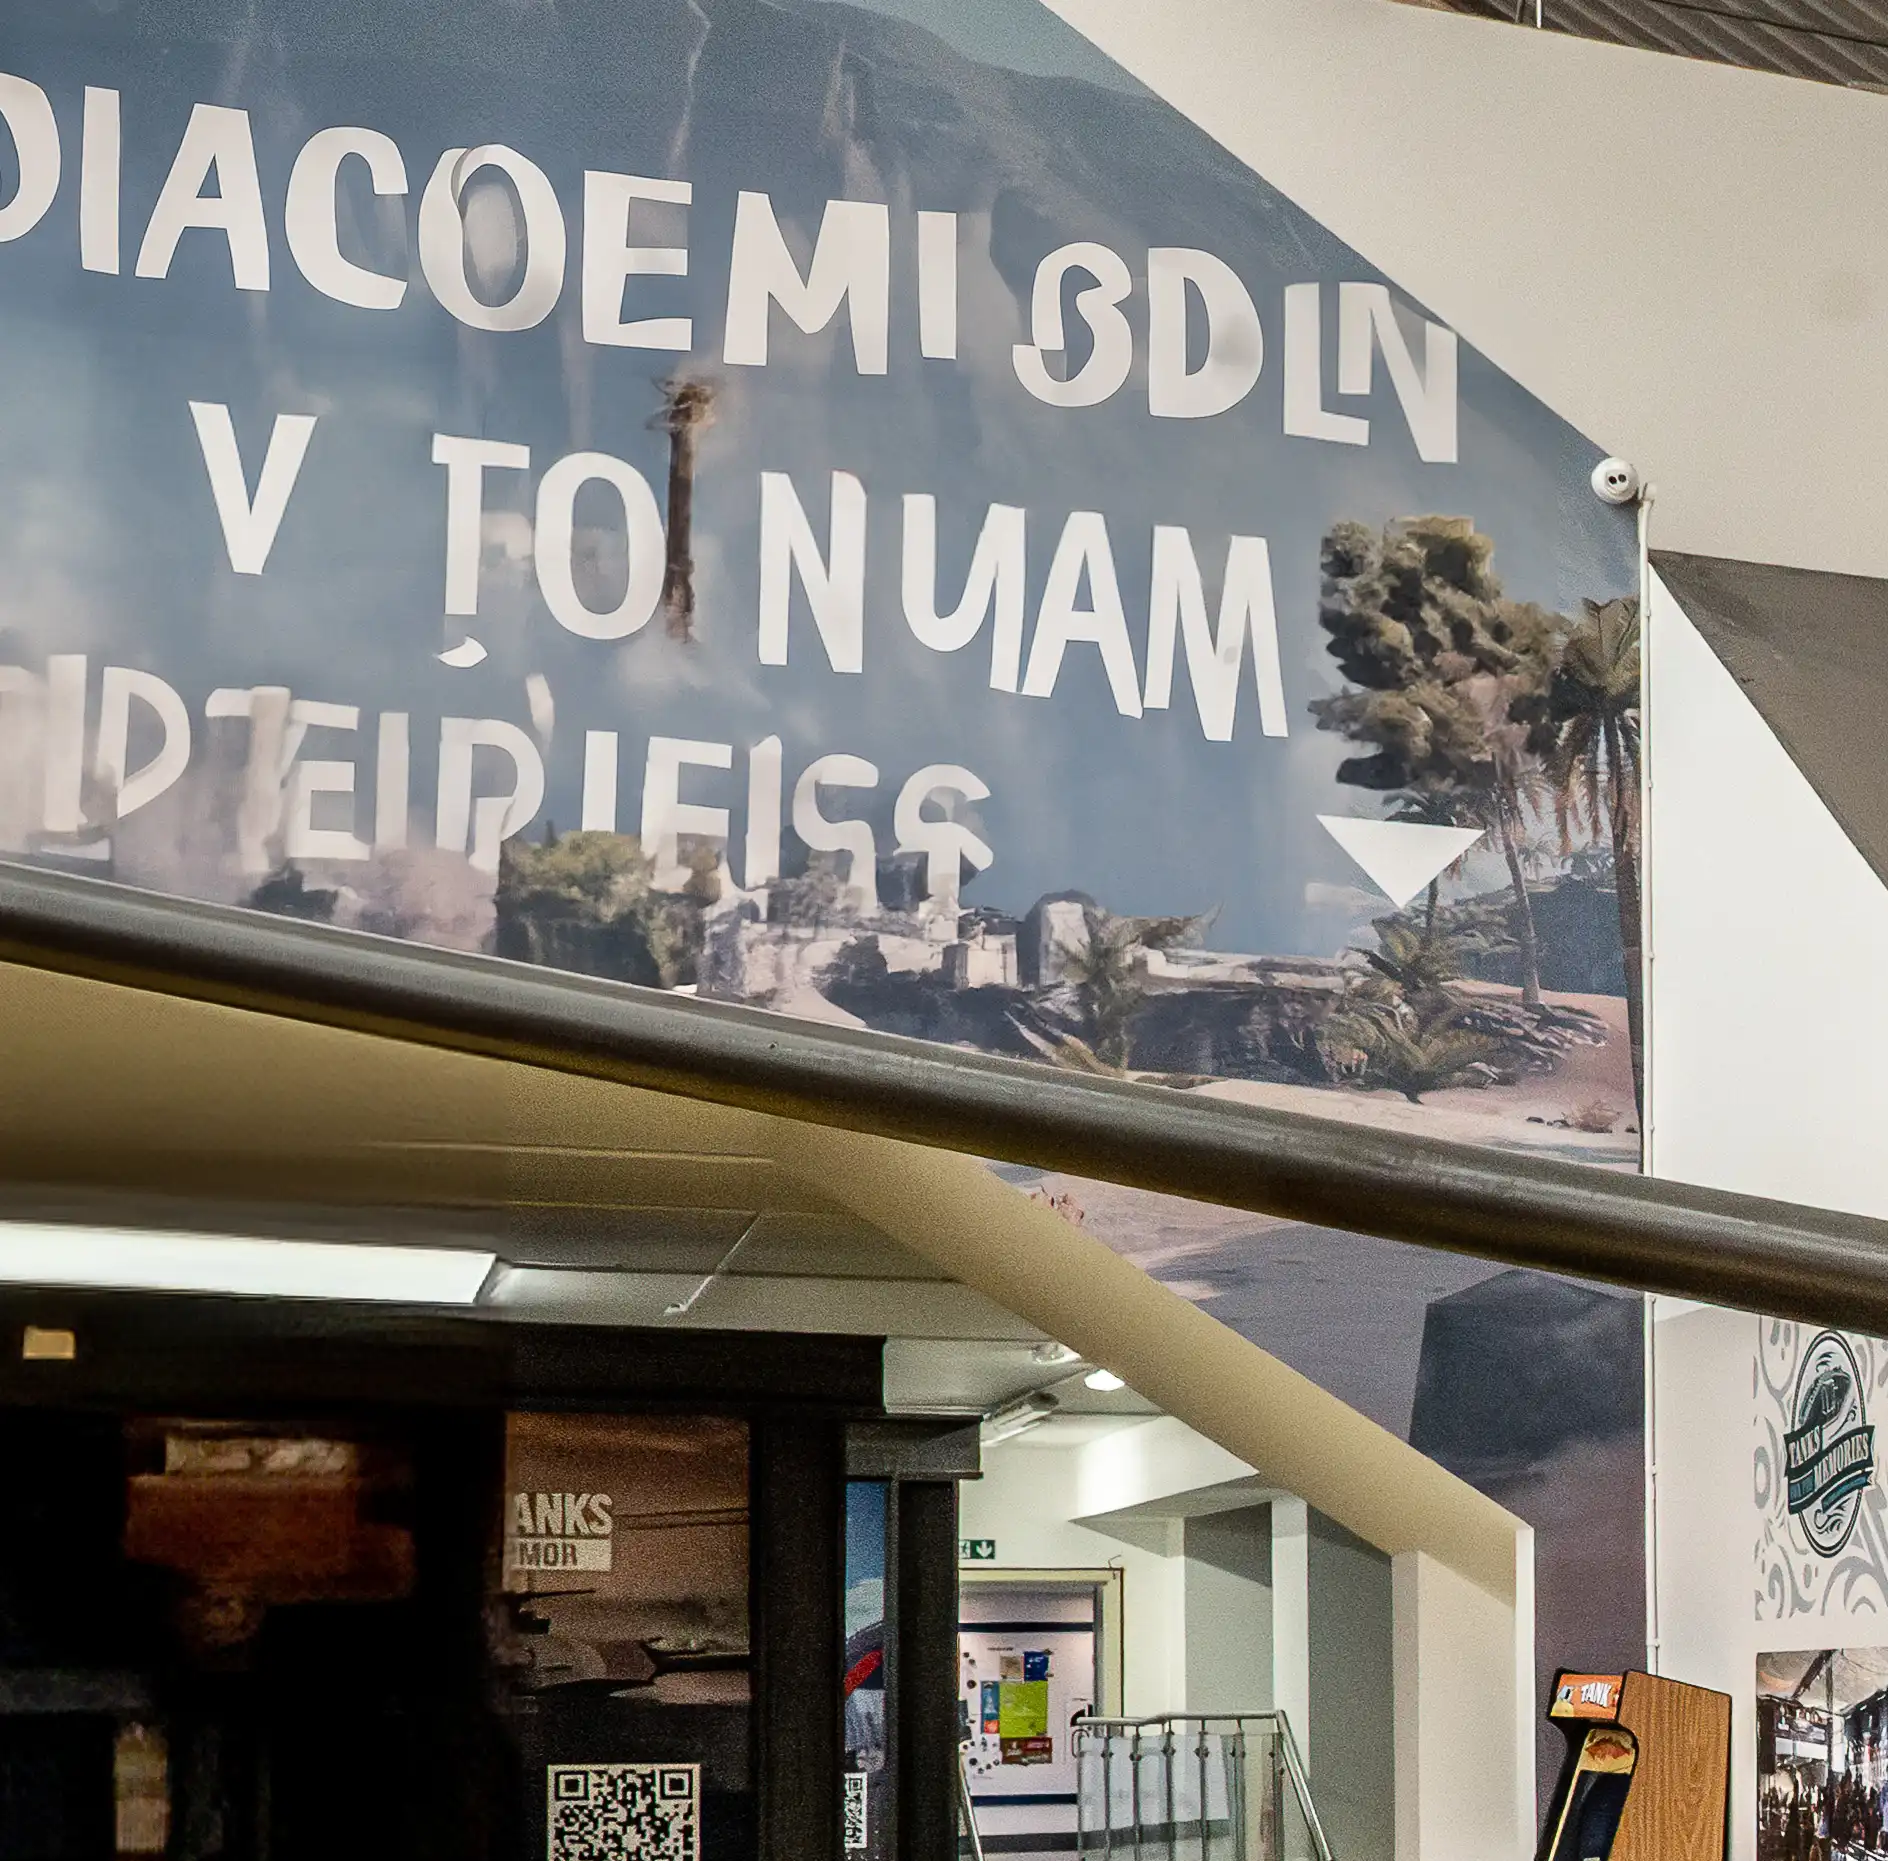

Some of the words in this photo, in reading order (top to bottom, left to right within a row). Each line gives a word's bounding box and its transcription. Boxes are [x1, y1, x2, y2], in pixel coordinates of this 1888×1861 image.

[1789, 1425, 1821, 1468] TANKS
[1813, 1432, 1869, 1491] MEMORIES
[513, 1492, 613, 1536] ANKS
[516, 1541, 578, 1567] MOR
[1580, 1682, 1613, 1708] TANK
